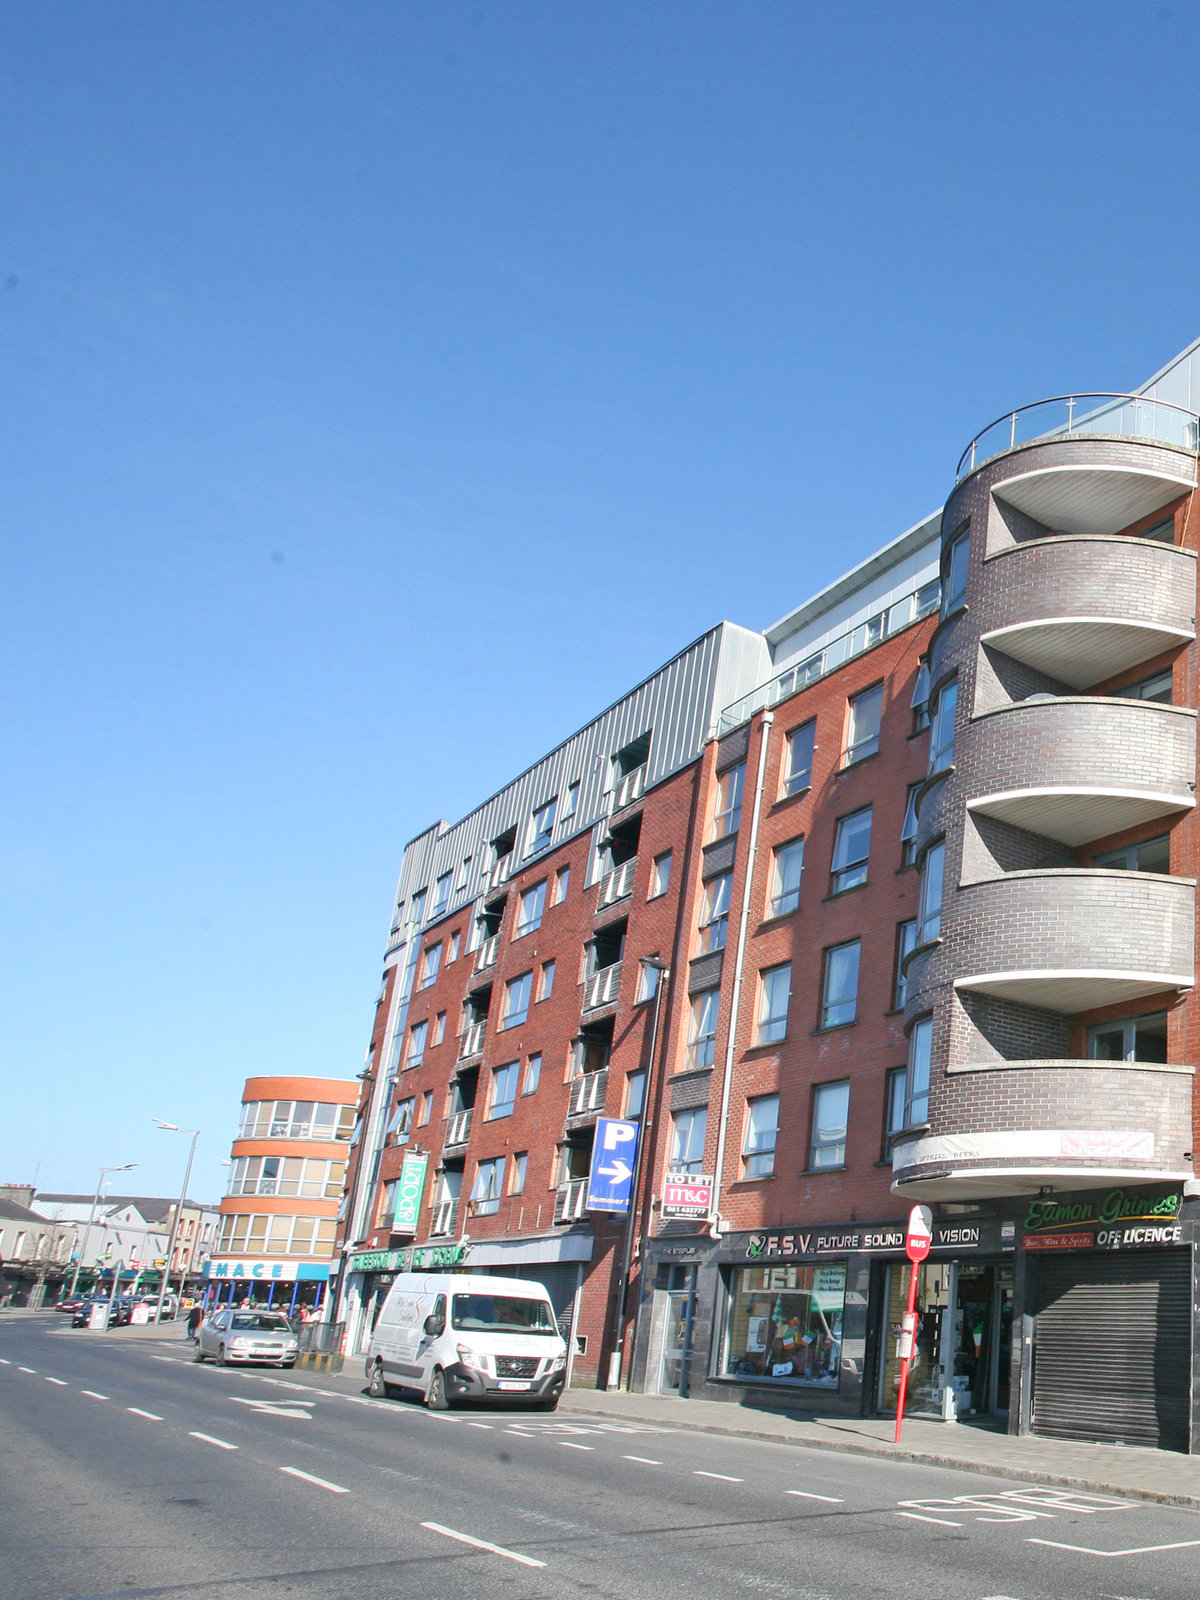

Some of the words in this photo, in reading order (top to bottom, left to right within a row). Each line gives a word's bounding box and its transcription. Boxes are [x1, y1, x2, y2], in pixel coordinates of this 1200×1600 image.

[603, 1122, 635, 1150] P
[667, 1175, 686, 1185] TO
[687, 1175, 711, 1186] LET
[398, 1163, 423, 1222] SPORT
[588, 1194, 624, 1206] Summer
[1023, 1199, 1093, 1229] Eamon
[1098, 1189, 1178, 1225] Grimes
[817, 1235, 859, 1249] FUTURE
[864, 1232, 904, 1247] SOUND
[940, 1227, 980, 1243] VISION
[910, 1238, 927, 1248] BUS
[1069, 1235, 1092, 1248] Spirits
[1097, 1230, 1122, 1245] OFF
[1123, 1226, 1183, 1244] LICENCE
[215, 1262, 283, 1278] MACE
[897, 1487, 1142, 1522] BUS
